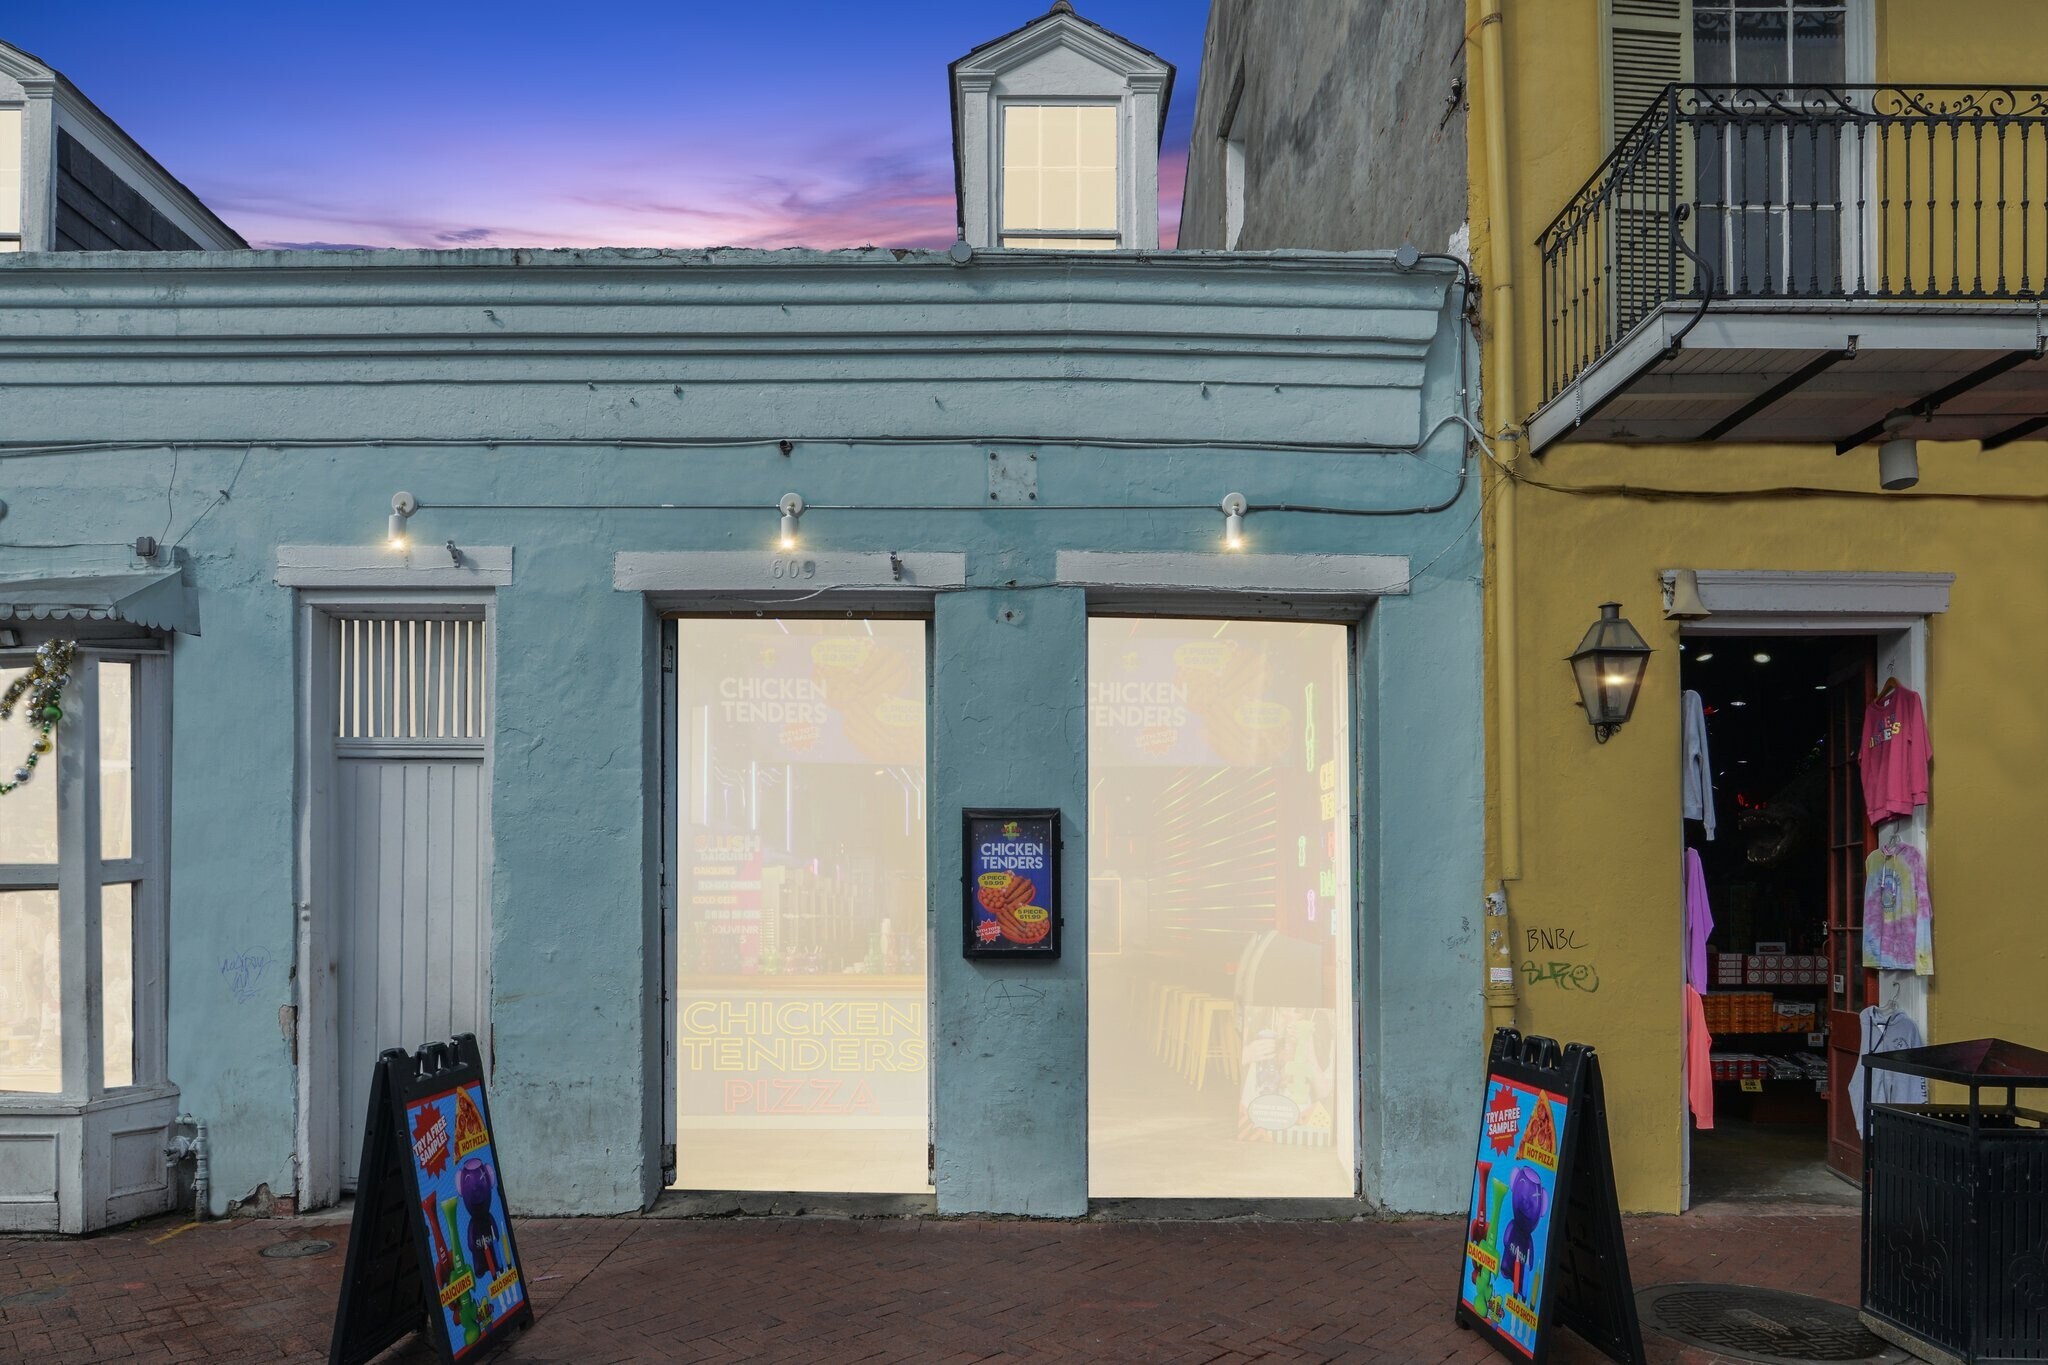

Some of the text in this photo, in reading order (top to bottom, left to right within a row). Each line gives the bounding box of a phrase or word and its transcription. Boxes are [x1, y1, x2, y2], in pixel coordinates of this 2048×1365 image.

[773, 560, 816, 580] 609
[720, 676, 828, 700] CHICKEN
[720, 700, 828, 724] TENDERS
[980, 842, 1043, 856] CHICKEN
[981, 856, 1043, 869] TENDERS
[682, 1000, 922, 1037] CHICKEN
[681, 1036, 928, 1072] TENDERS
[723, 1077, 881, 1115] PIZZA
[1486, 1110, 1499, 1124] TRY
[1504, 1107, 1521, 1120] FREE
[1489, 1119, 1517, 1135] SAMPLE!
[413, 1133, 427, 1156] TRY
[430, 1115, 447, 1139] FREE
[461, 1135, 488, 1151] HOT PIZZA
[420, 1130, 448, 1166] SAMPLE!
[1526, 1146, 1554, 1168] HOT PIZZA
[1468, 1244, 1496, 1270] DAIQUIRIS
[440, 1276, 472, 1305] DAIQUIRIS
